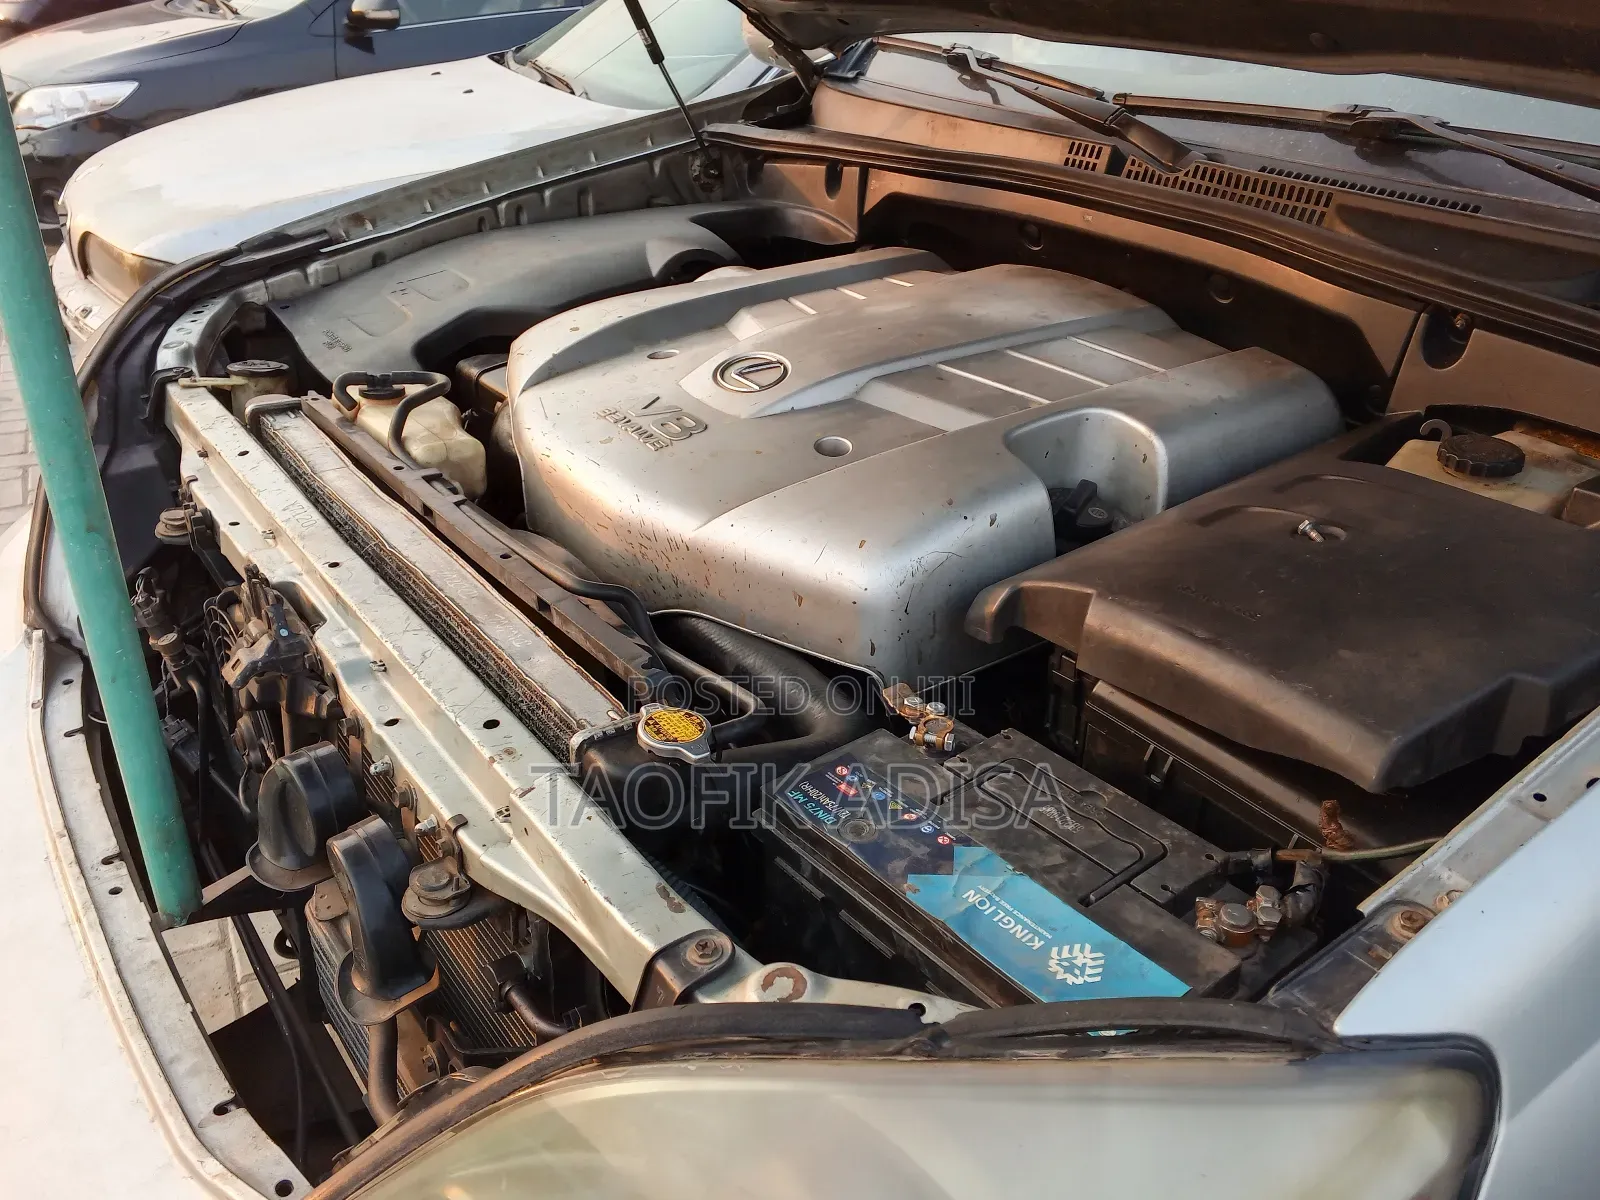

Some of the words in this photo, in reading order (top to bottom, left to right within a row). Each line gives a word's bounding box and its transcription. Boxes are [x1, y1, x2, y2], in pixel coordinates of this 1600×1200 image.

[627, 394, 708, 441] V8
[787, 790, 809, 803] MF
[804, 802, 837, 825] DIN75
[962, 889, 1045, 951] KINGLION
